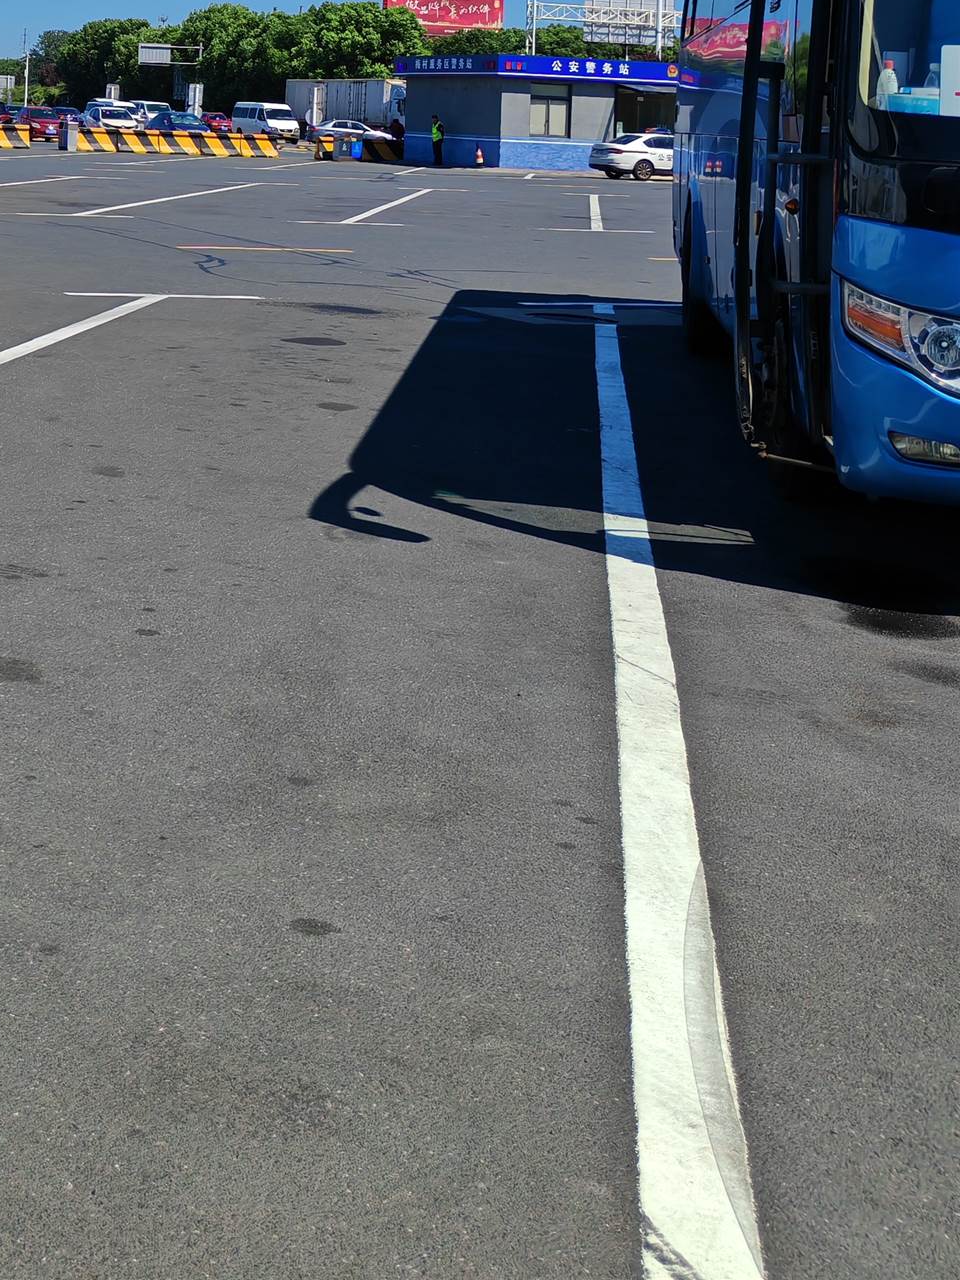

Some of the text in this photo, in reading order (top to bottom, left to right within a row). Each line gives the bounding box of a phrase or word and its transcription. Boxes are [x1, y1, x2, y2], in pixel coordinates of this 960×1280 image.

[551, 60, 630, 76] 公安警务站
